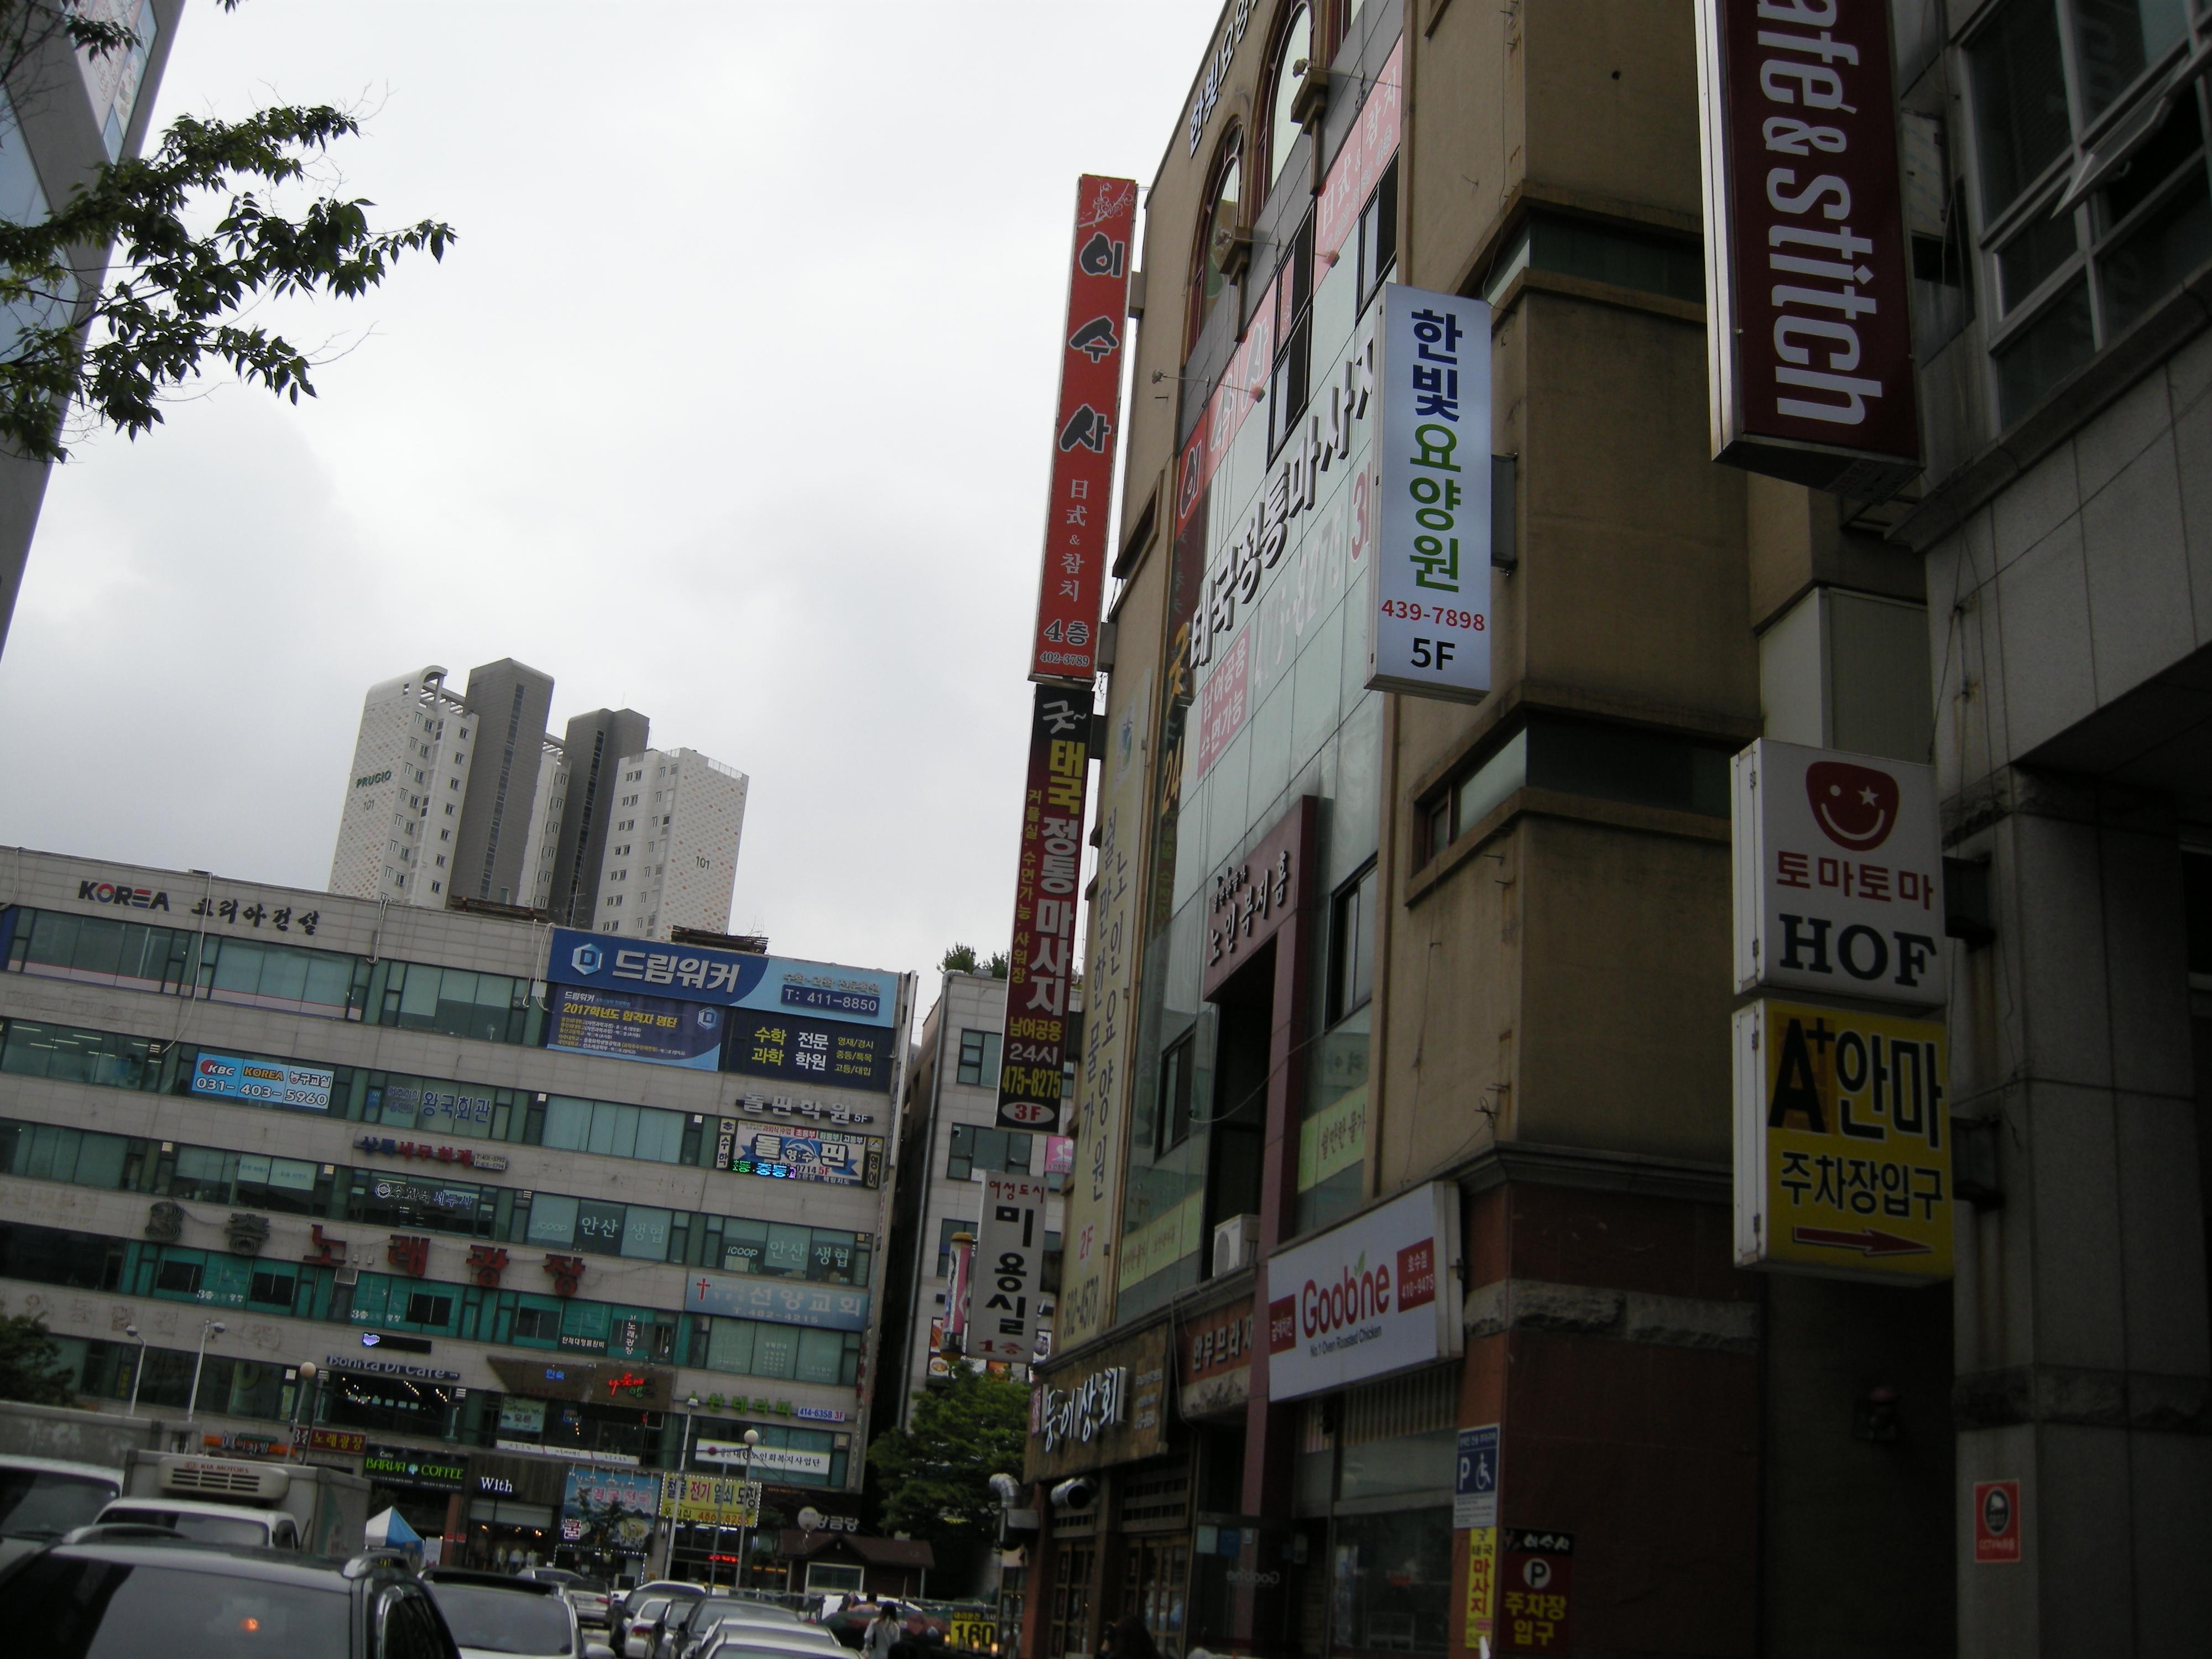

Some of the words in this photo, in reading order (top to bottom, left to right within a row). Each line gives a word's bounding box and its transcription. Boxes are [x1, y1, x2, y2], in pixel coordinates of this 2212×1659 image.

[1060, 231, 1125, 453] 이수사
[1058, 553, 1085, 603] 참치
[1381, 599, 1486, 632] 439-7898
[1044, 619, 1089, 646] 4층
[1040, 651, 1090, 668] 402-3789
[1410, 638, 1455, 670] 5F
[356, 770, 392, 787] PRUGIO
[1048, 739, 1086, 815] 태국
[363, 800, 375, 812] 101
[696, 855, 711, 870] 101
[1040, 816, 1079, 894] 정통
[1776, 851, 1933, 910] 토마토마
[79, 880, 170, 911] KOREA
[191, 899, 320, 935] 코리아건설
[1026, 898, 1074, 1017] 마사지
[1779, 913, 1937, 987] HOF
[612, 949, 741, 994] 드림워커
[564, 991, 595, 1003] 드림워커
[807, 992, 877, 1011] 411-8850
[563, 1003, 620, 1020] 2017학년도
[623, 1010, 654, 1024] 합격자
[656, 1016, 679, 1028] 명단
[754, 1026, 786, 1045] 수학
[798, 1031, 829, 1050] 전문
[838, 1037, 874, 1049] 영재/경시
[1009, 1017, 1062, 1043] 남여공용
[752, 1046, 784, 1066] 과학
[795, 1051, 826, 1071] 학원
[1009, 1043, 1058, 1066] 24시
[208, 1065, 236, 1076] KBC
[243, 1067, 284, 1081] KOREA
[290, 1072, 332, 1088] 농구교실
[834, 1064, 871, 1076] 고등/대입
[1001, 1065, 1062, 1100] 475-8275
[285, 1090, 328, 1105] 5960
[1836, 1030, 1943, 1149] 안마
[422, 1091, 491, 1123] 왕국회관
[744, 1093, 850, 1124] 돌핀학원
[854, 1114, 868, 1123] 5F
[1014, 1104, 1042, 1121] 3F
[818, 1166, 830, 1175] 5F
[989, 1180, 1045, 1204] 여성도시
[1781, 1151, 1943, 1220] 주차장입구
[581, 1216, 619, 1239] 안산
[769, 1240, 806, 1264] 안산
[815, 1245, 850, 1268] 생협
[985, 1206, 1035, 1335] 미용실
[750, 1286, 862, 1317] 선양교회
[1302, 1264, 1390, 1339] Goobne
[978, 1339, 1024, 1355] 1층
[800, 1408, 833, 1419] 414-6358
[834, 1411, 845, 1420] 3F
[313, 1432, 363, 1452] 노래광장
[421, 1464, 464, 1481] COFFEE
[480, 1475, 514, 1494] With
[1458, 1456, 1470, 1491] P
[690, 1480, 711, 1504] 전기
[1470, 1557, 1491, 1615] 마사지
[1530, 1562, 1547, 1586] P
[1504, 1590, 1567, 1621] 주차장
[1513, 1619, 1555, 1647] 입구
